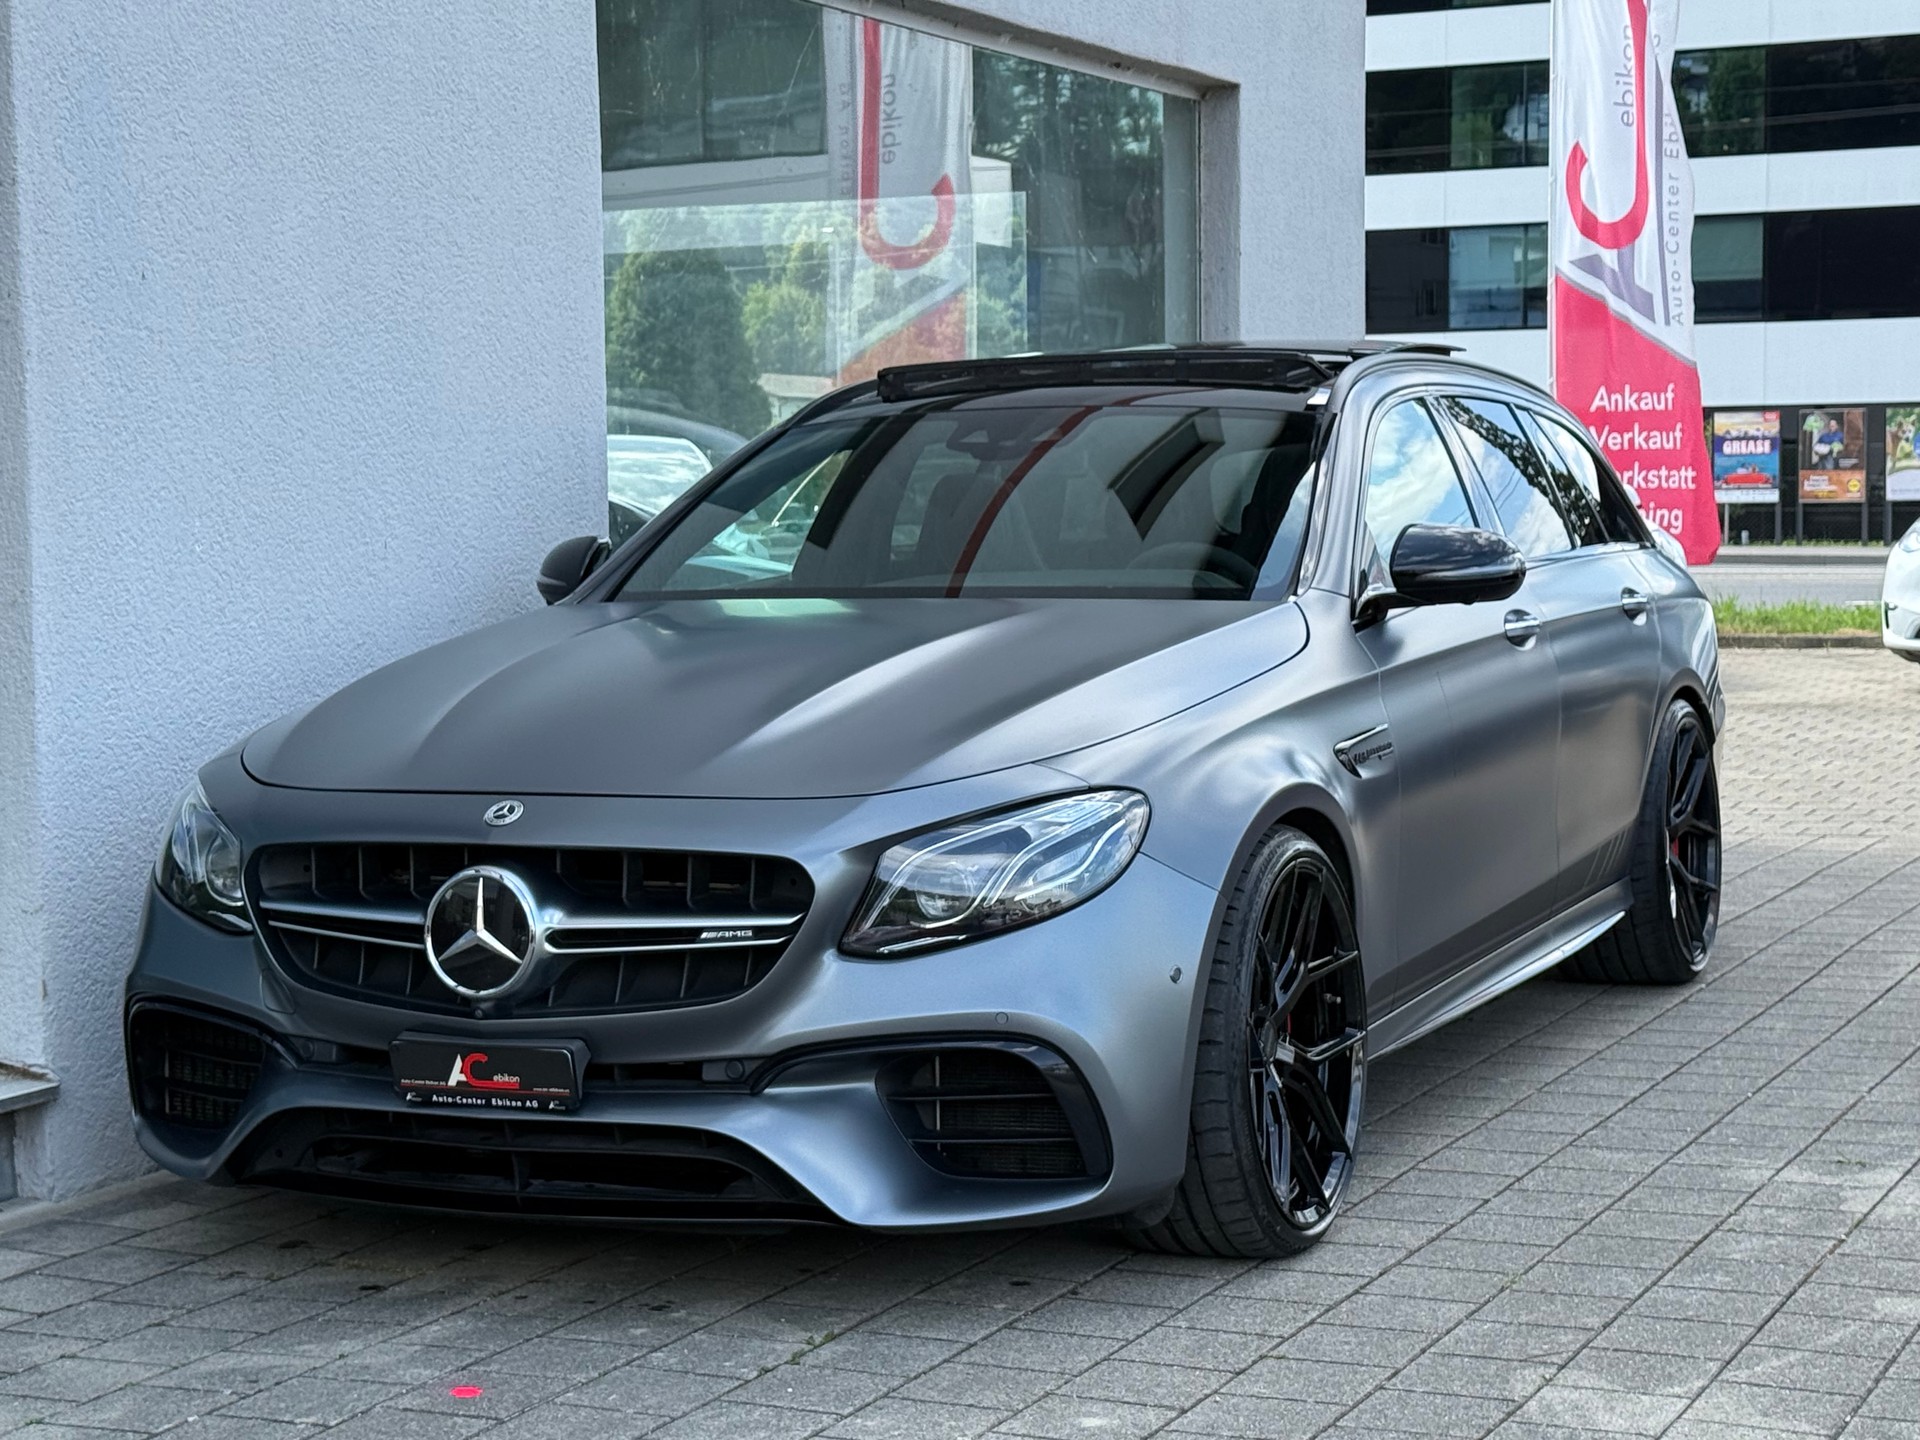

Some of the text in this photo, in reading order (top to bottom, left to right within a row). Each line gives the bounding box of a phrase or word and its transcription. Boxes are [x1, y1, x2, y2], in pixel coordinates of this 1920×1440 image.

[1613, 25, 1635, 127] ebikon
[1665, 173, 1684, 325] Auto-Center
[1589, 383, 1675, 412] Ankauf
[1589, 422, 1683, 450] Verkauf
[1723, 439, 1772, 455] GREASE
[1615, 461, 1697, 490] rkstatt
[716, 929, 753, 938] AMG
[493, 1073, 520, 1083] ebikon
[432, 1094, 486, 1105] Auto-Center
[491, 1098, 522, 1107] Ebikon
[525, 1100, 539, 1108] AG
